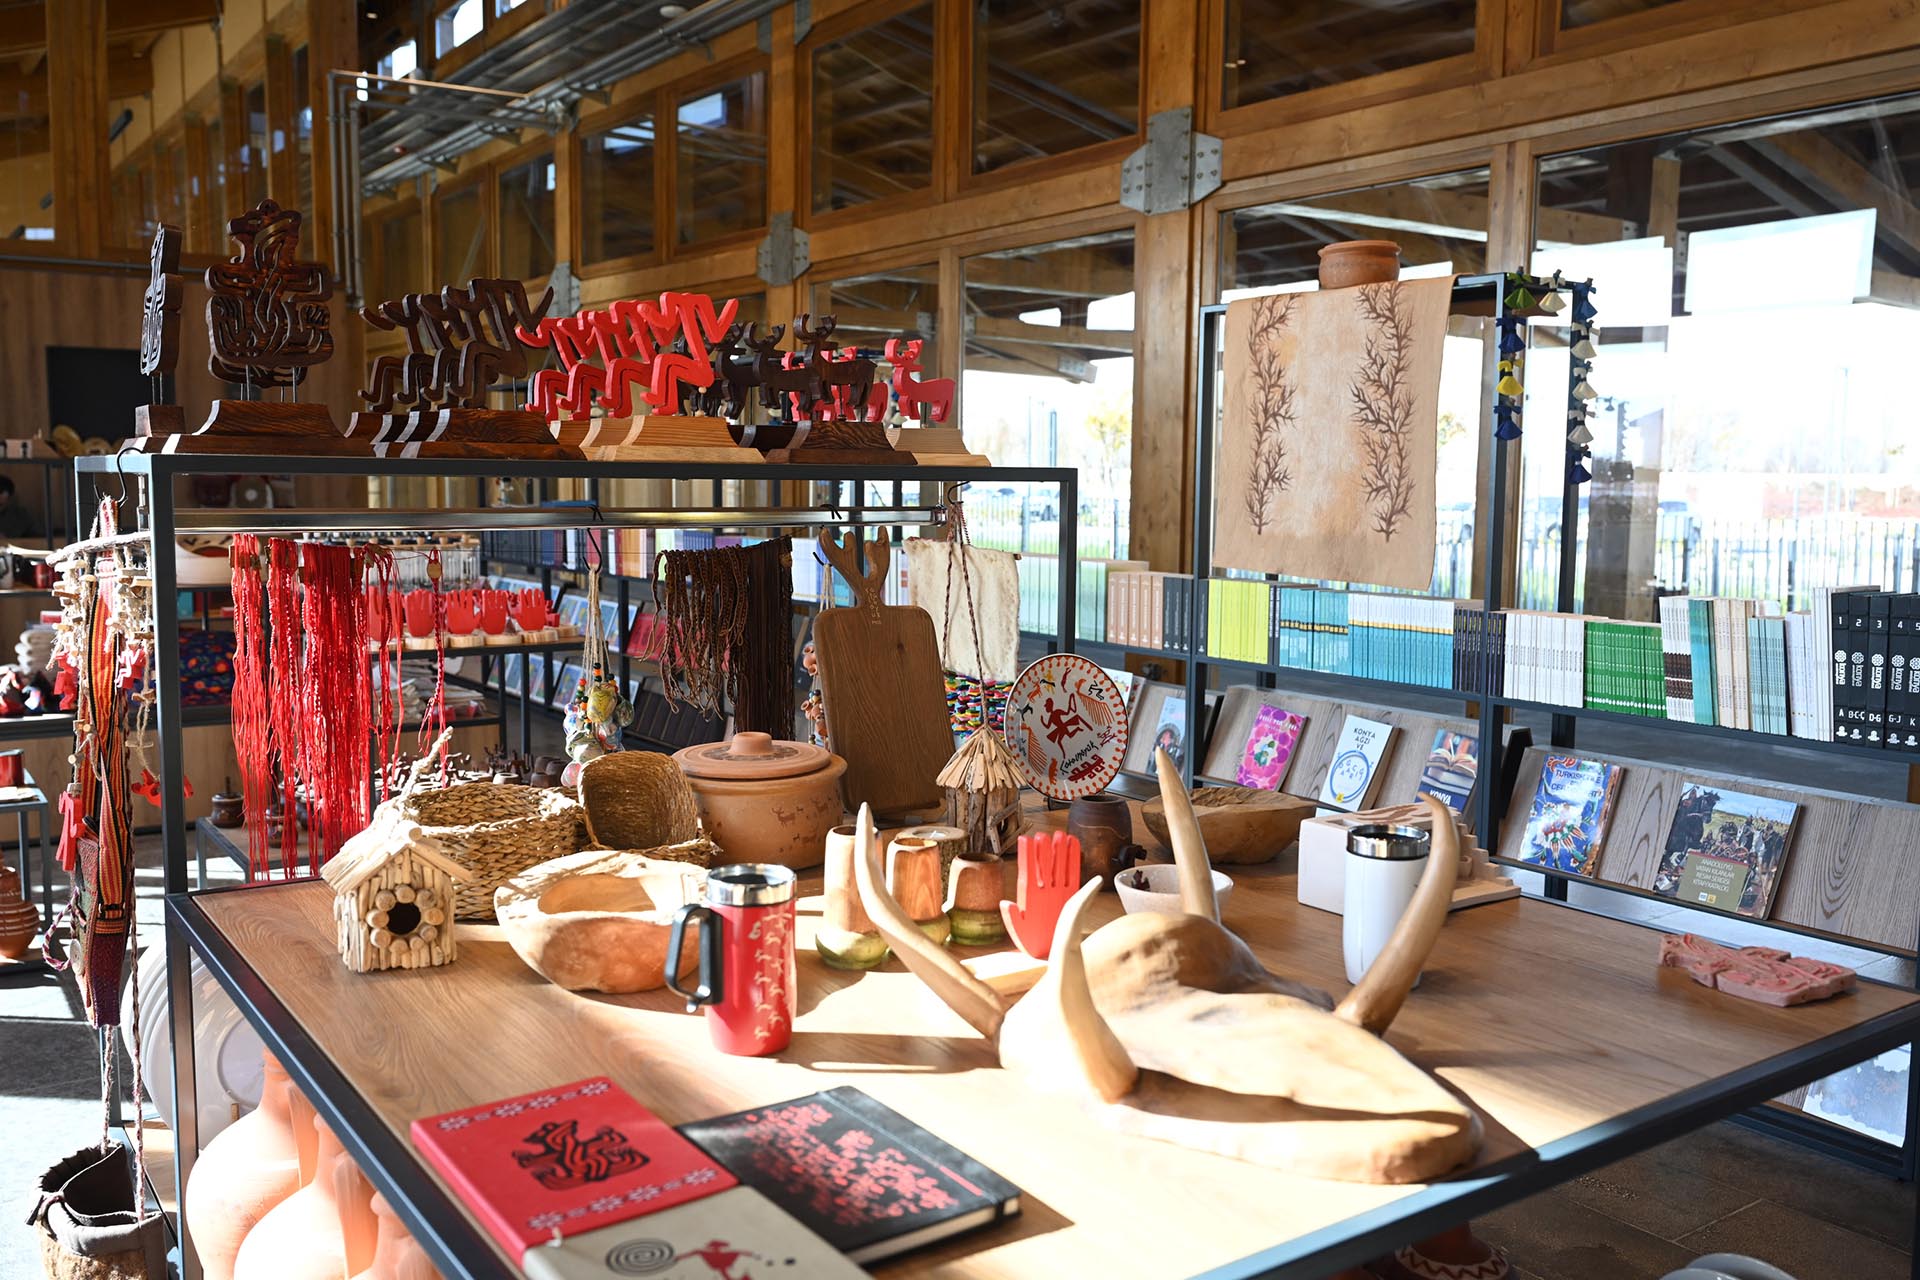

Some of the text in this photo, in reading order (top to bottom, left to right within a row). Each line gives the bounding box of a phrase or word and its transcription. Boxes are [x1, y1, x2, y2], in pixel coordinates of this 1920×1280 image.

[1838, 616, 1843, 625] 1
[1855, 618, 1862, 627] 2
[1876, 620, 1882, 629] 3
[1897, 621, 1903, 629] 4
[1915, 622, 1920, 631] 5
[1839, 663, 1847, 685] konya
[1855, 664, 1864, 687] konya
[1875, 666, 1884, 689] konya
[1894, 668, 1904, 691] konya
[1838, 708, 1844, 717] A
[1909, 717, 1916, 726] K
[1353, 727, 1376, 739] KONYA
